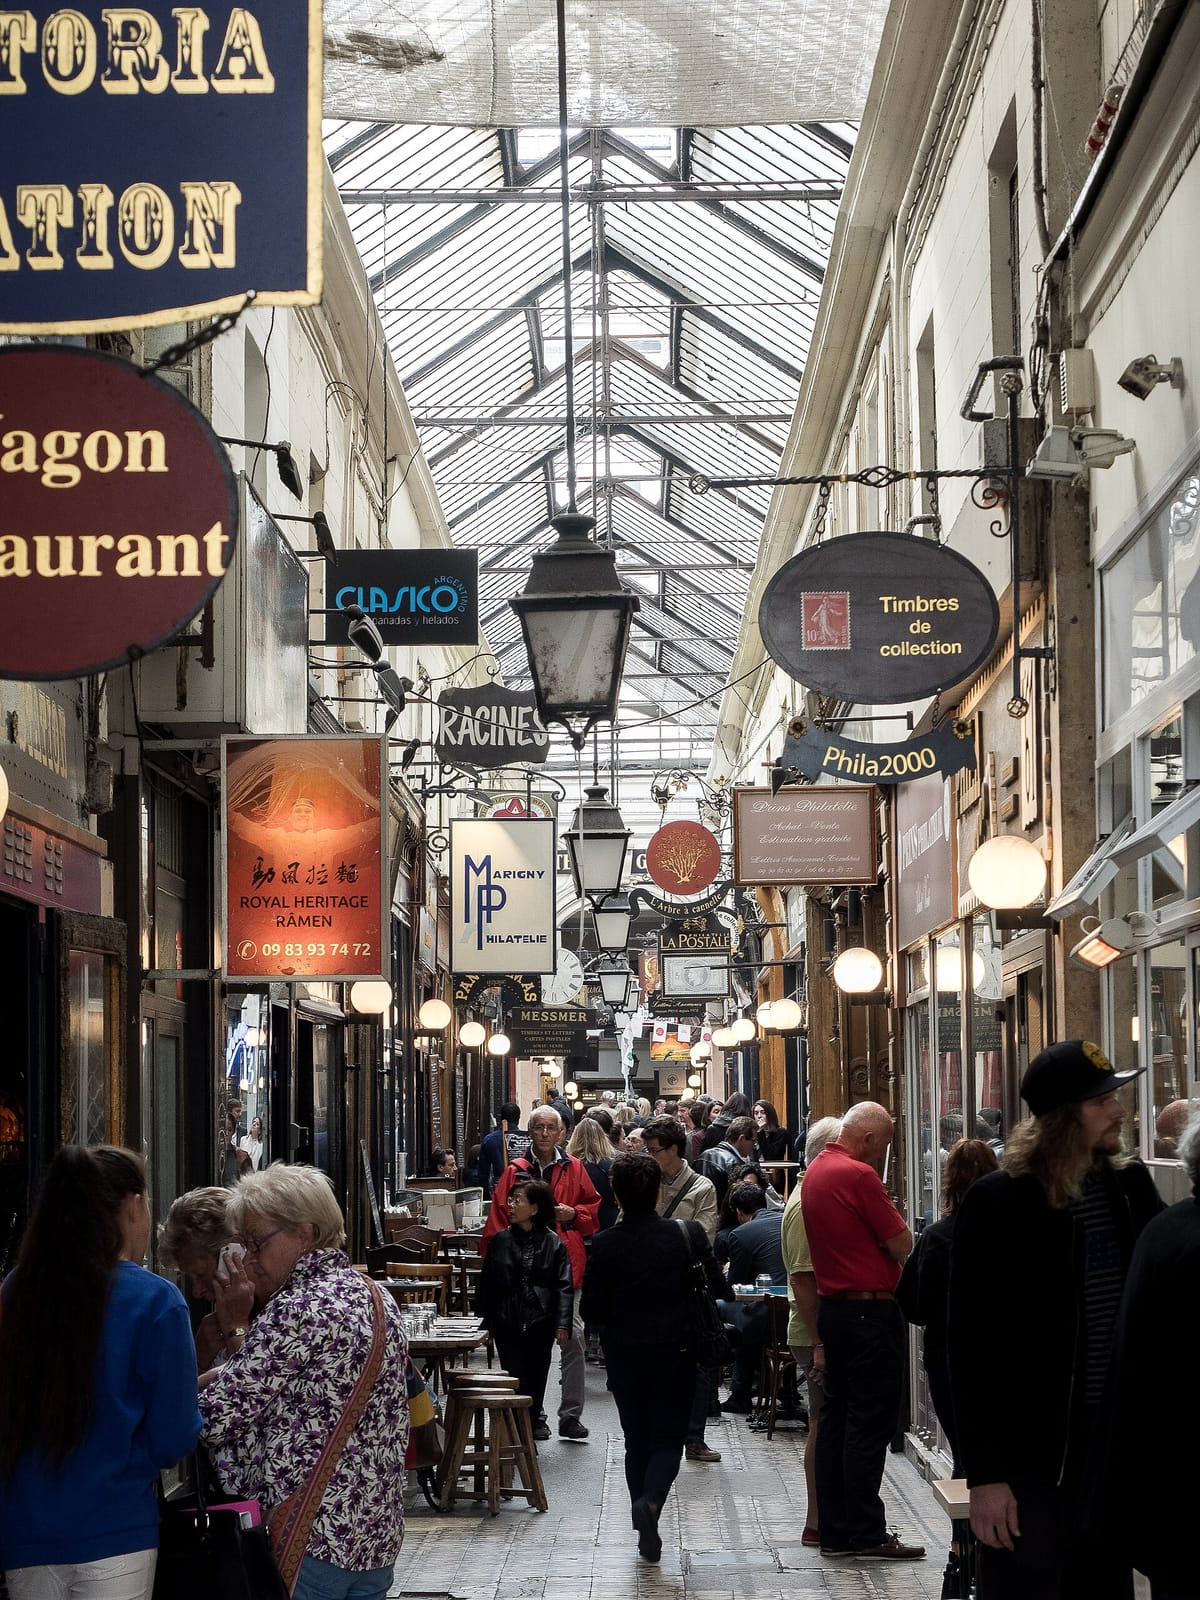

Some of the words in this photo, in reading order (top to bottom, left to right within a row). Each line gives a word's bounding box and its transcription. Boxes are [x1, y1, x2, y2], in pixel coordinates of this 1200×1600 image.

[0, 414, 168, 489] agon
[335, 585, 459, 613] CLASICO
[879, 596, 960, 613] Timbres
[415, 618, 420, 626] y
[422, 615, 460, 625] helados
[909, 620, 932, 634] de
[879, 641, 963, 657] collection
[440, 705, 550, 747] RACINES
[822, 746, 936, 776] Phila2000
[240, 896, 290, 909] ROYAL
[294, 896, 368, 908] HERITAGE
[650, 896, 681, 915] L'Arbre
[684, 905, 689, 914] à
[692, 893, 722, 914] cannelle
[276, 912, 332, 927] RÂMEN
[660, 934, 676, 948] LA
[678, 934, 731, 948] POSTALE
[262, 943, 281, 956] 09
[285, 943, 303, 956] 83
[307, 943, 326, 956] 93
[330, 943, 349, 956] 74
[352, 943, 371, 956] 72
[521, 1011, 588, 1022] MESSMER
